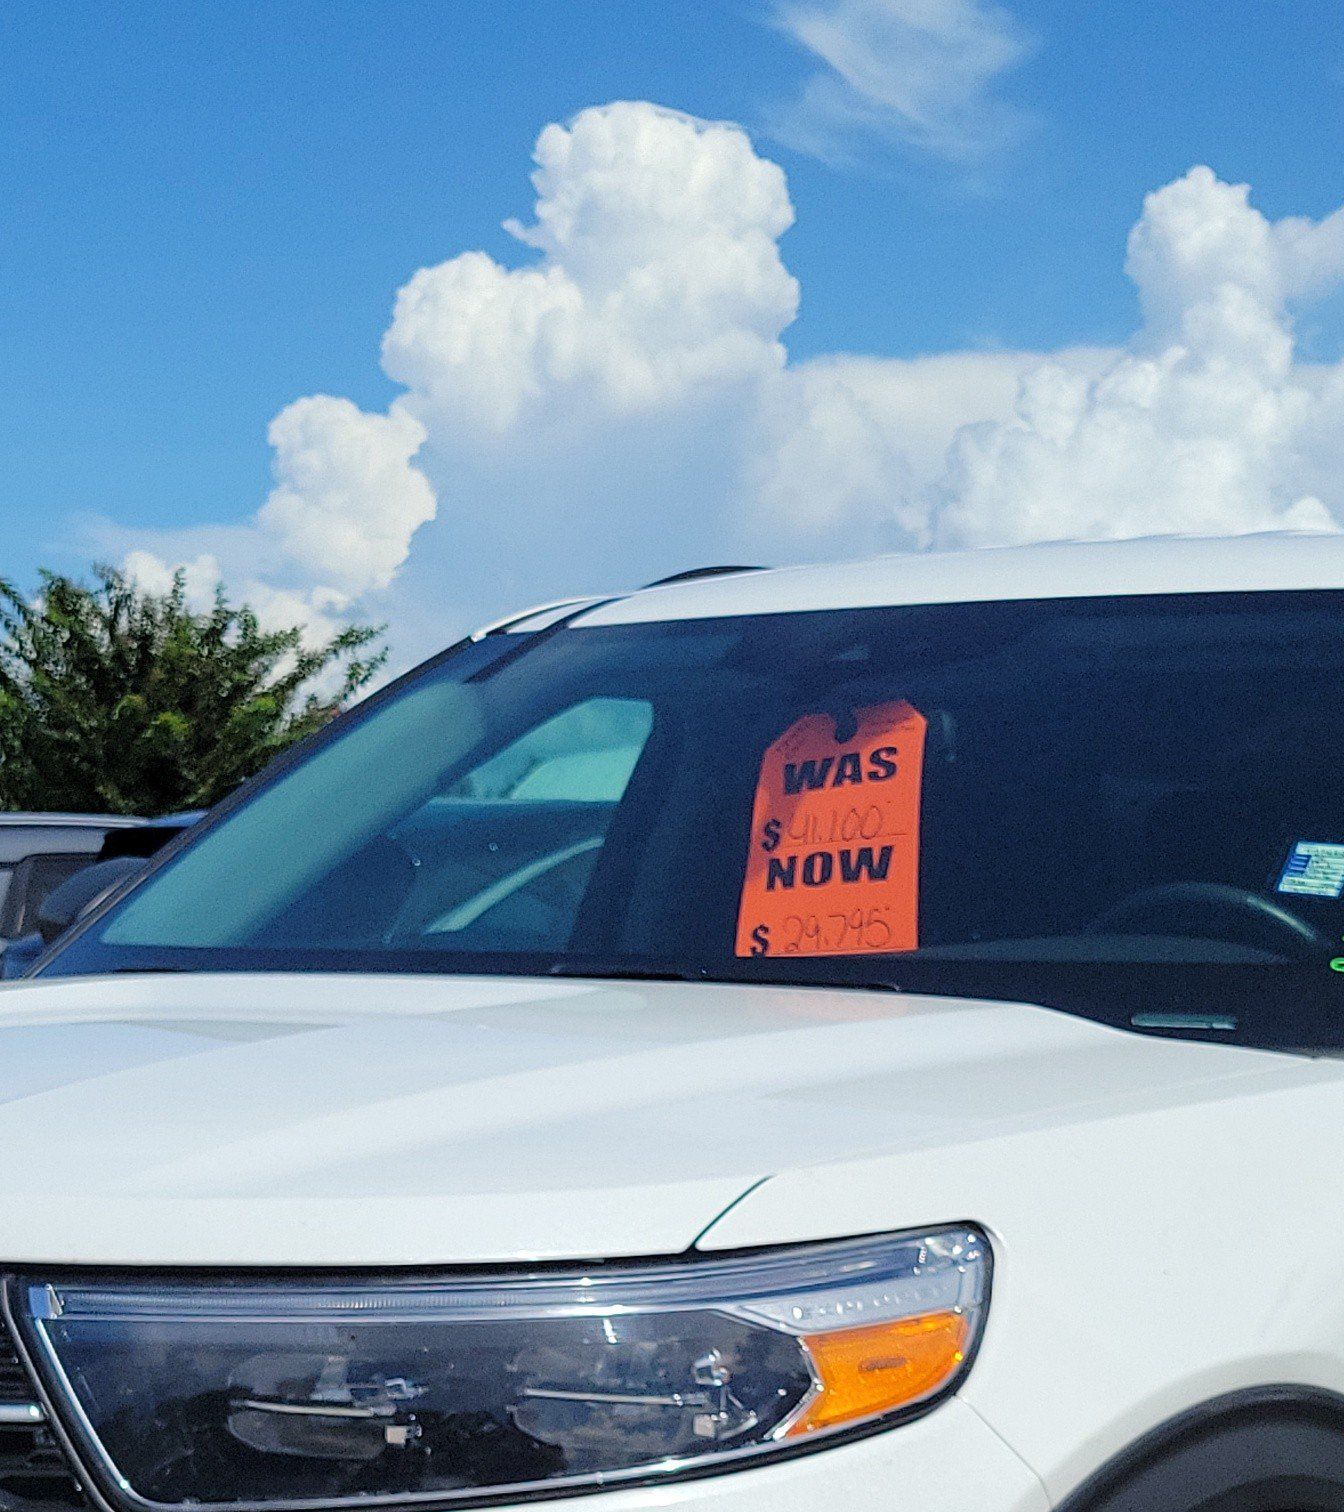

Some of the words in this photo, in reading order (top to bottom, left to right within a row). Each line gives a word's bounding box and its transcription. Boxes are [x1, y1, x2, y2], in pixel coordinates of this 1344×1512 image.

[784, 746, 898, 796] WAS
[761, 818, 782, 851] $
[766, 845, 895, 892] NOW
[750, 924, 771, 956] $
